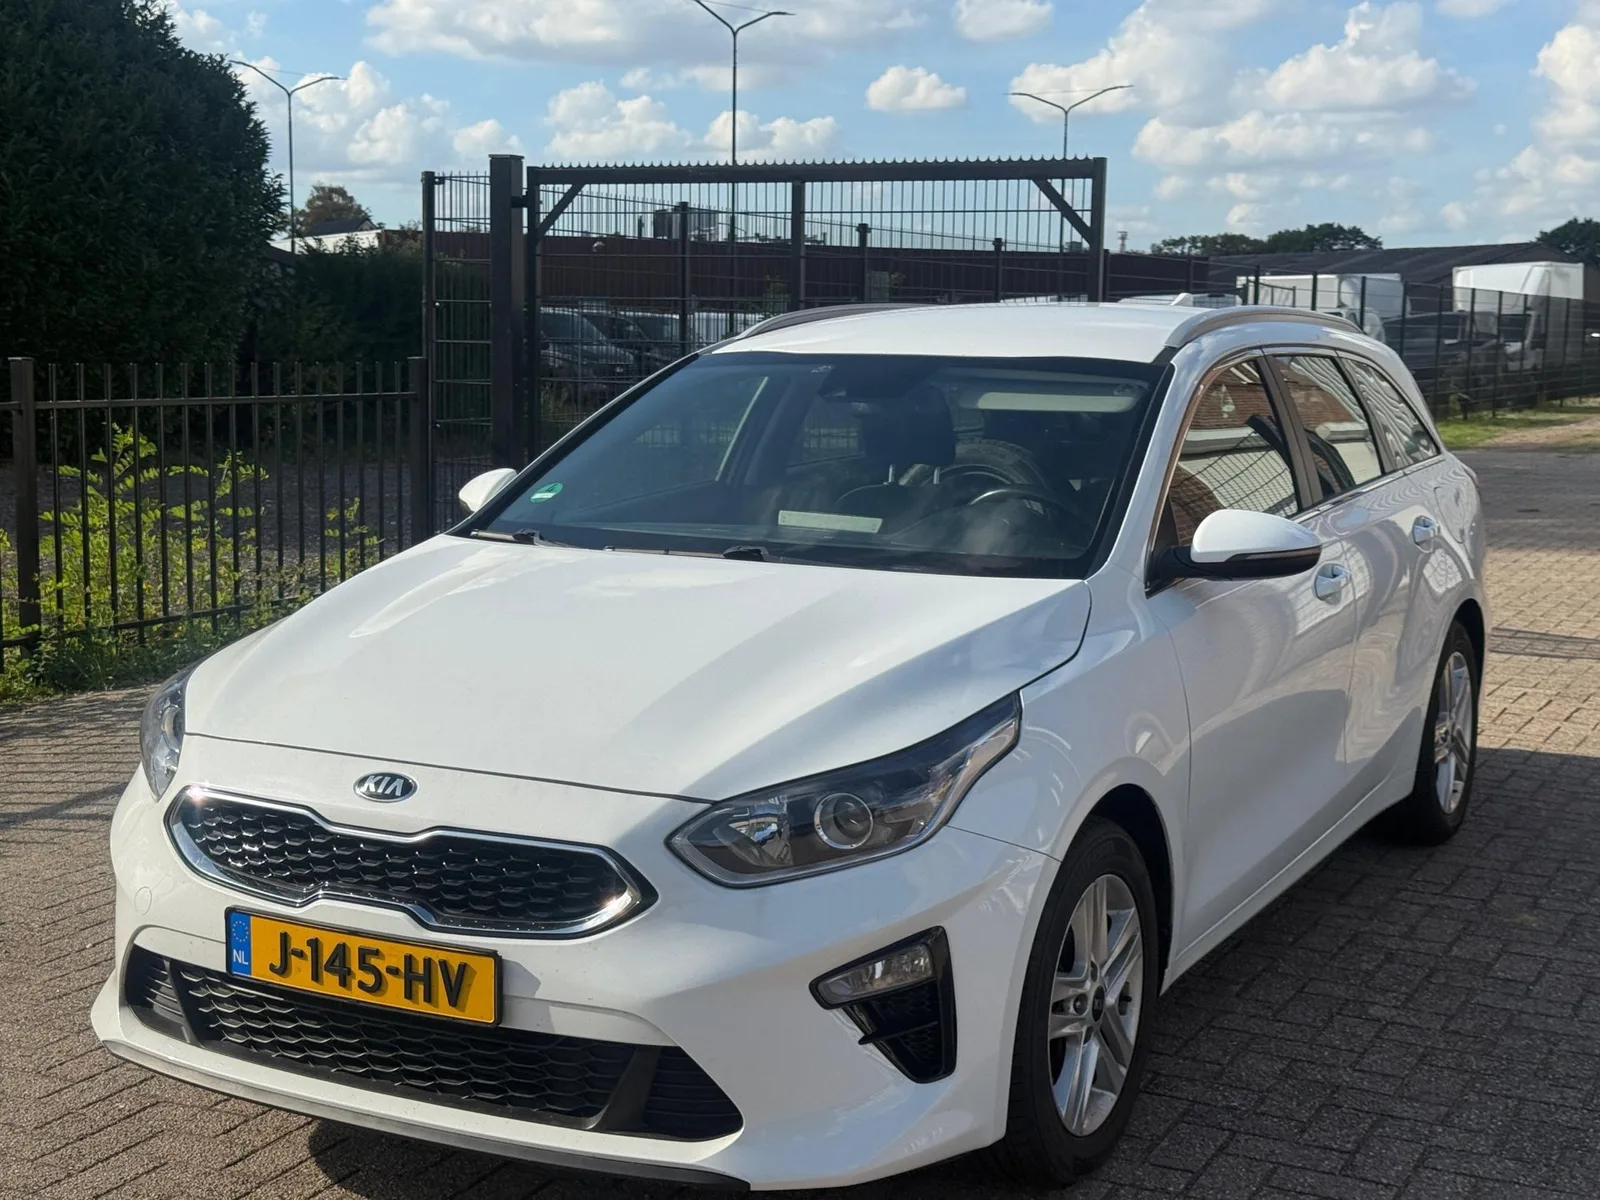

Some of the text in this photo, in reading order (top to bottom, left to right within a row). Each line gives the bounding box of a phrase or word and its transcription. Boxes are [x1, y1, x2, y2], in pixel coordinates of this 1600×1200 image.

[360, 775, 404, 796] KIA
[232, 949, 249, 965] NL
[269, 931, 467, 1007] J-145-HV
